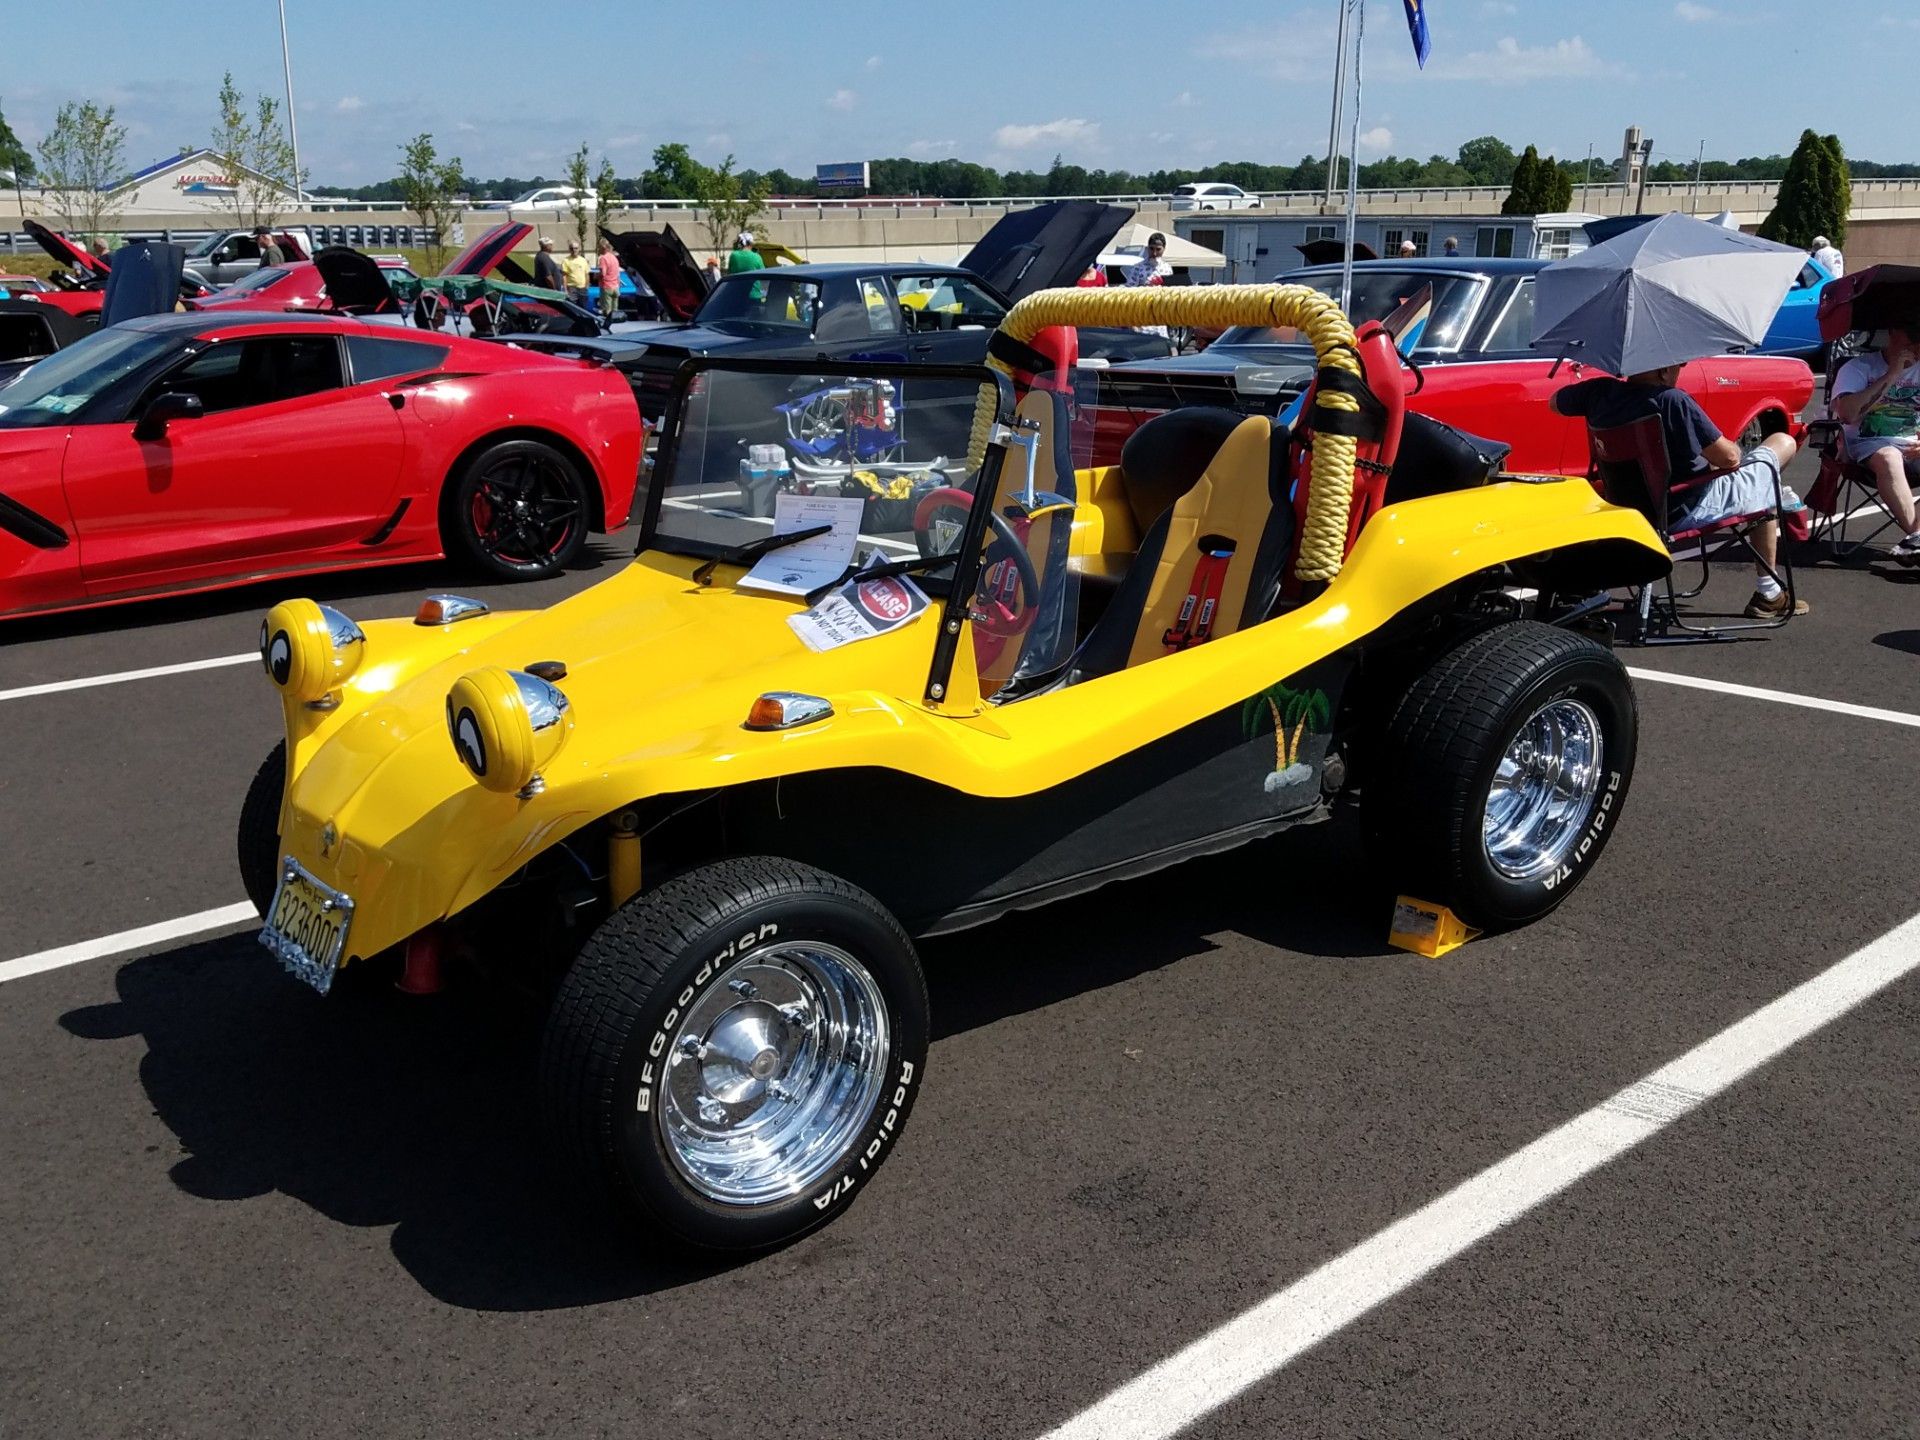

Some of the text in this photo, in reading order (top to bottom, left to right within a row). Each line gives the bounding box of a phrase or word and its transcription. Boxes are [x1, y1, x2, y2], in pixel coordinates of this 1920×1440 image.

[815, 618, 832, 630] NOT
[1543, 770, 1621, 890] Radial T/A
[637, 923, 778, 1112] BFGoodrich
[813, 1061, 914, 1210] Radial T/A
